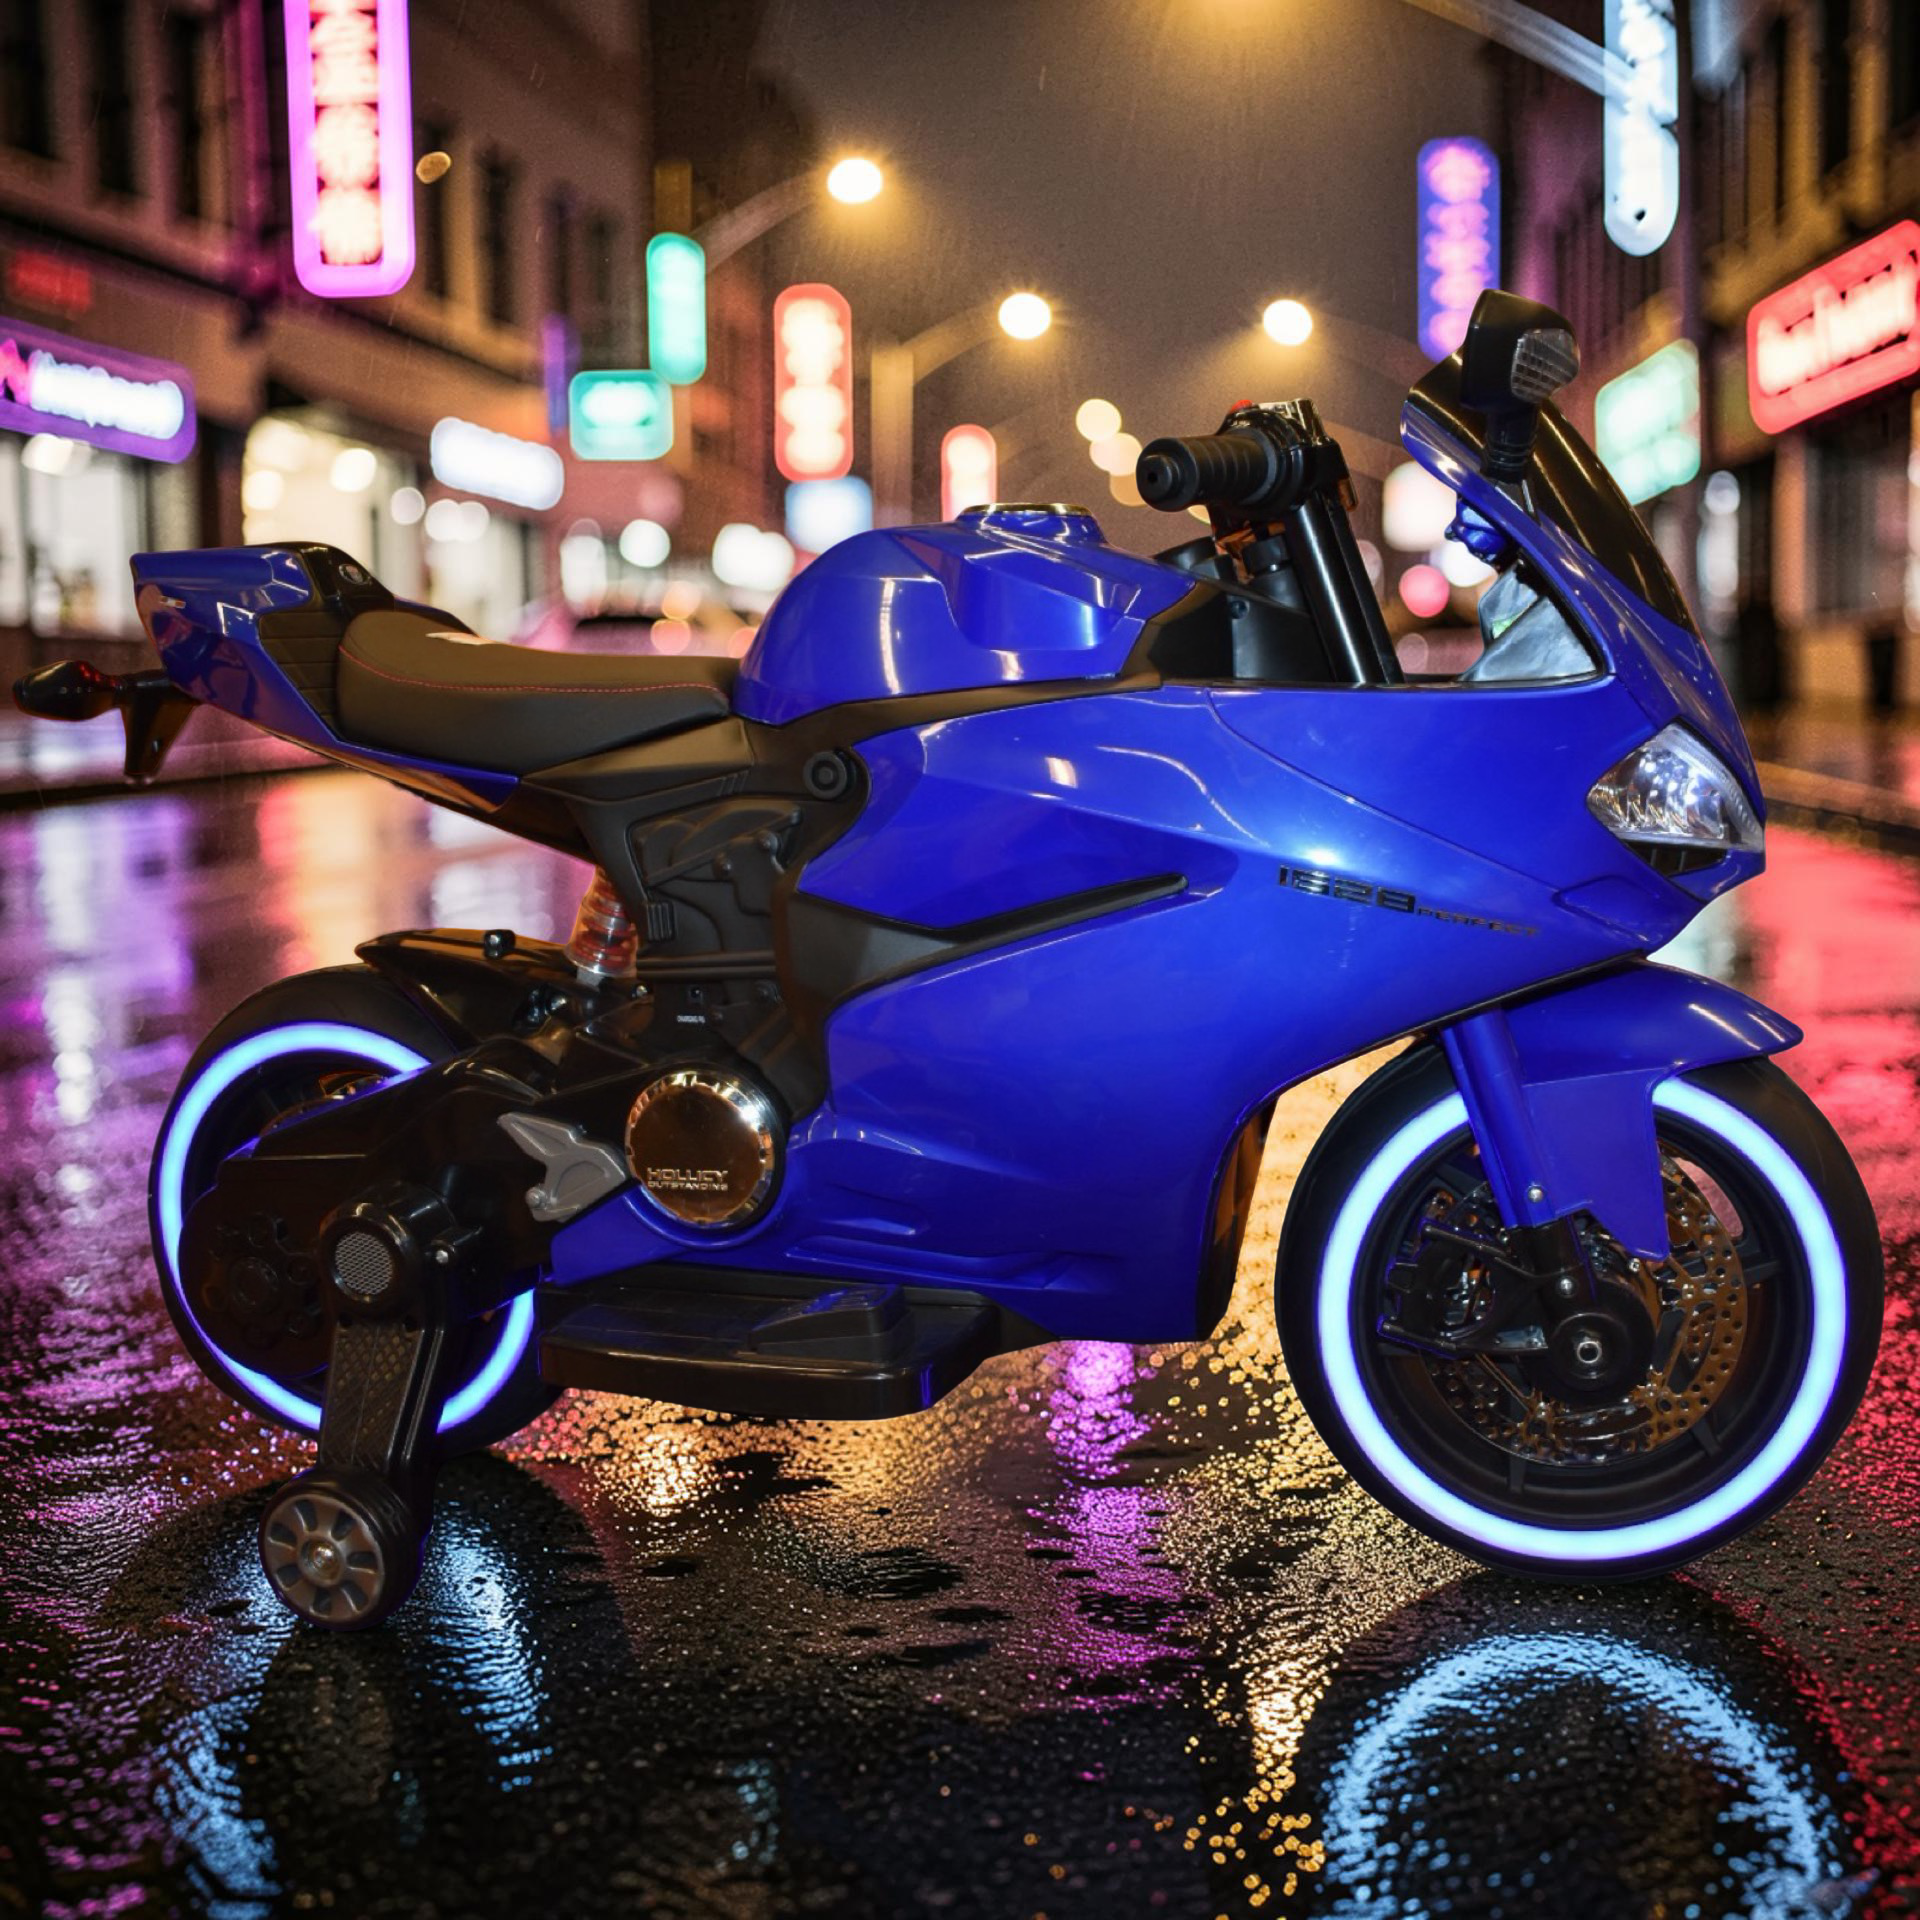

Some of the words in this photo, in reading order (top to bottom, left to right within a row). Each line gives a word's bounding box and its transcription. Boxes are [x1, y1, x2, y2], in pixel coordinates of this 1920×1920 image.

[1418, 907, 1538, 936] PERFECT
[647, 1167, 729, 1183] HOLLICY
[647, 1181, 729, 1192] OUTSTANDING
